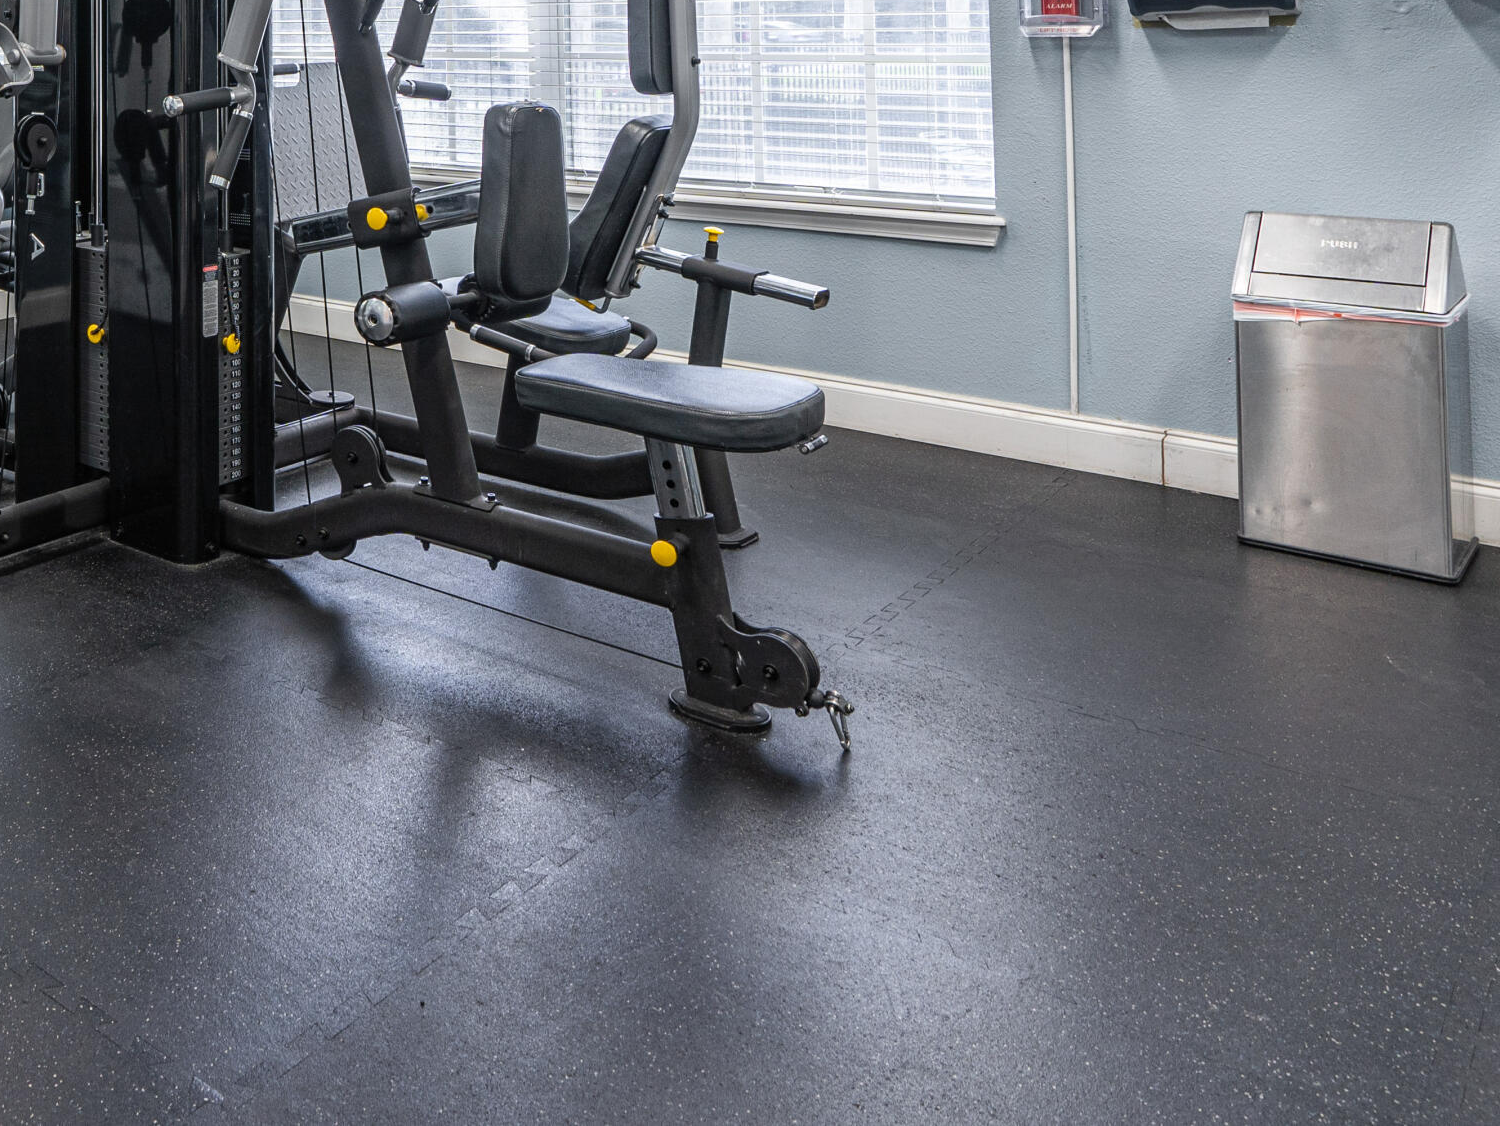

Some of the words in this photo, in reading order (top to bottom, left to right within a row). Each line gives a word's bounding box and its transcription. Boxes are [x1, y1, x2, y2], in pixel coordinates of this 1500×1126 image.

[232, 280, 240, 288] 30
[231, 358, 241, 366] 100
[231, 370, 241, 378] 110
[231, 392, 241, 400] 130
[231, 403, 241, 411] 140
[231, 426, 241, 434] 160
[231, 437, 241, 445] 170
[231, 459, 241, 467] 190
[231, 470, 241, 479] 200
